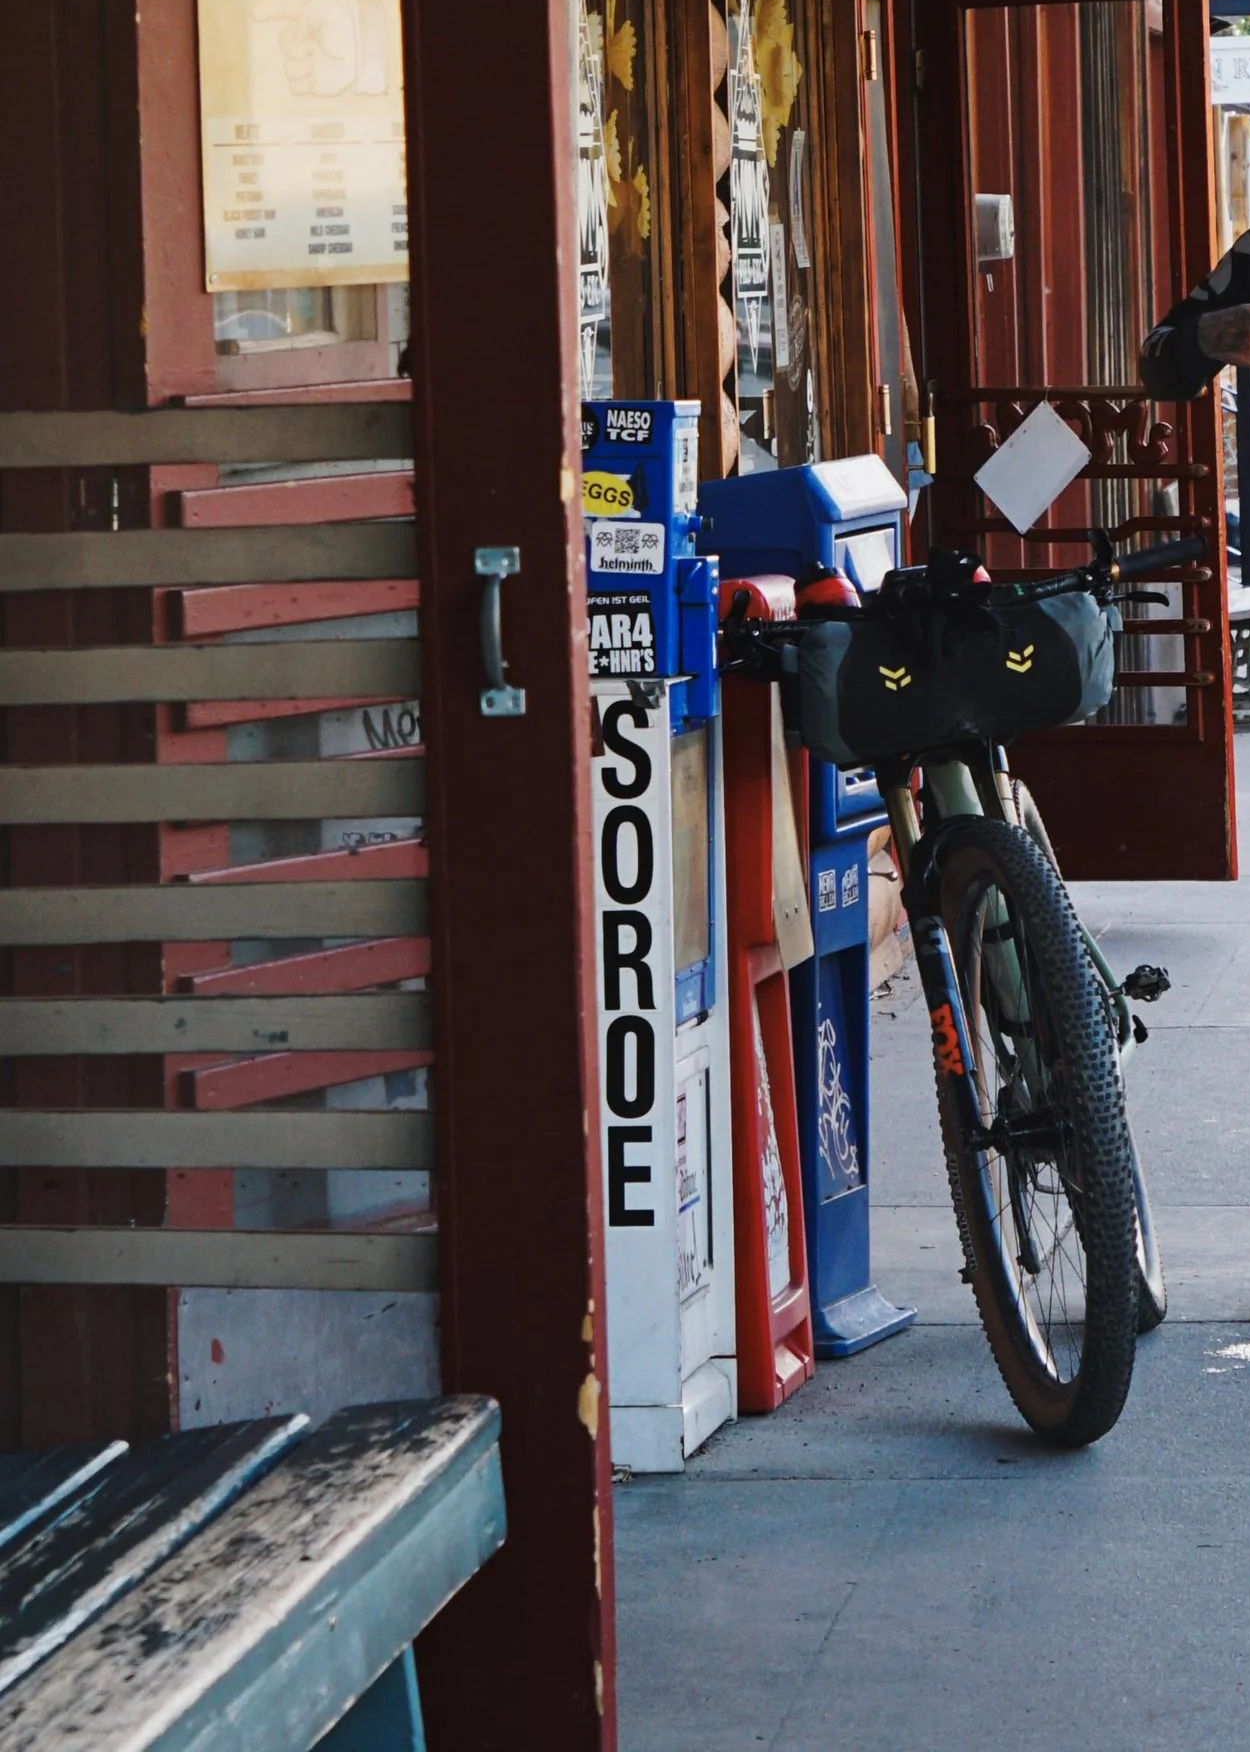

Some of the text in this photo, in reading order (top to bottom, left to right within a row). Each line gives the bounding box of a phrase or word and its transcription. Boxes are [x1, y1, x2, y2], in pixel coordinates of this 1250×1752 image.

[606, 408, 652, 430] NAESO
[606, 428, 650, 442] TCF
[612, 596, 627, 605] IST
[629, 595, 651, 605] GEIL
[600, 699, 657, 1228] SOROE
